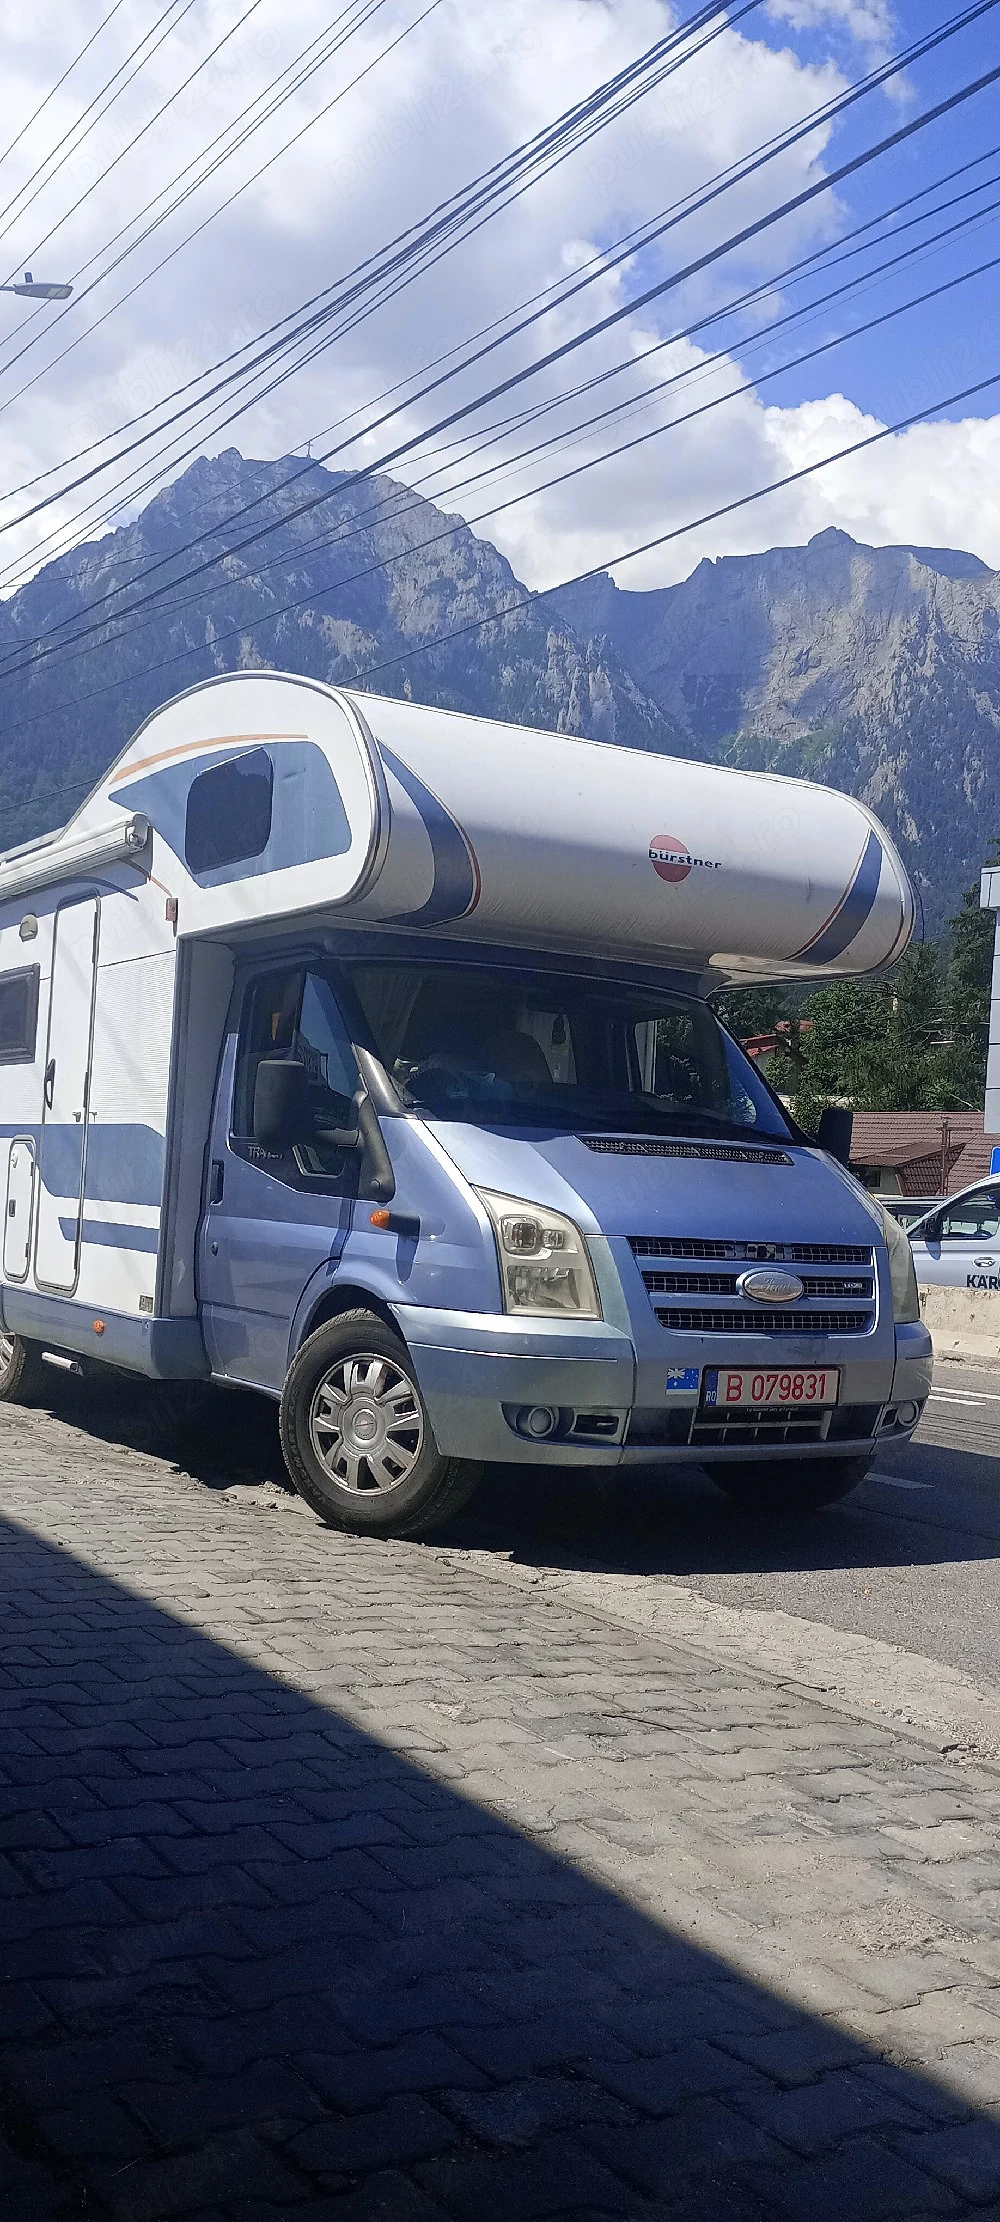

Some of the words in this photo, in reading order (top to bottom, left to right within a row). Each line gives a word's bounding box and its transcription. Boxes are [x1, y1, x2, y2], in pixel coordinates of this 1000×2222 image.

[648, 849, 722, 868] bürstner
[966, 1274, 1000, 1290] KÄR
[726, 1374, 743, 1401] B
[751, 1373, 826, 1401] 079831
[706, 1390, 717, 1402] RO
